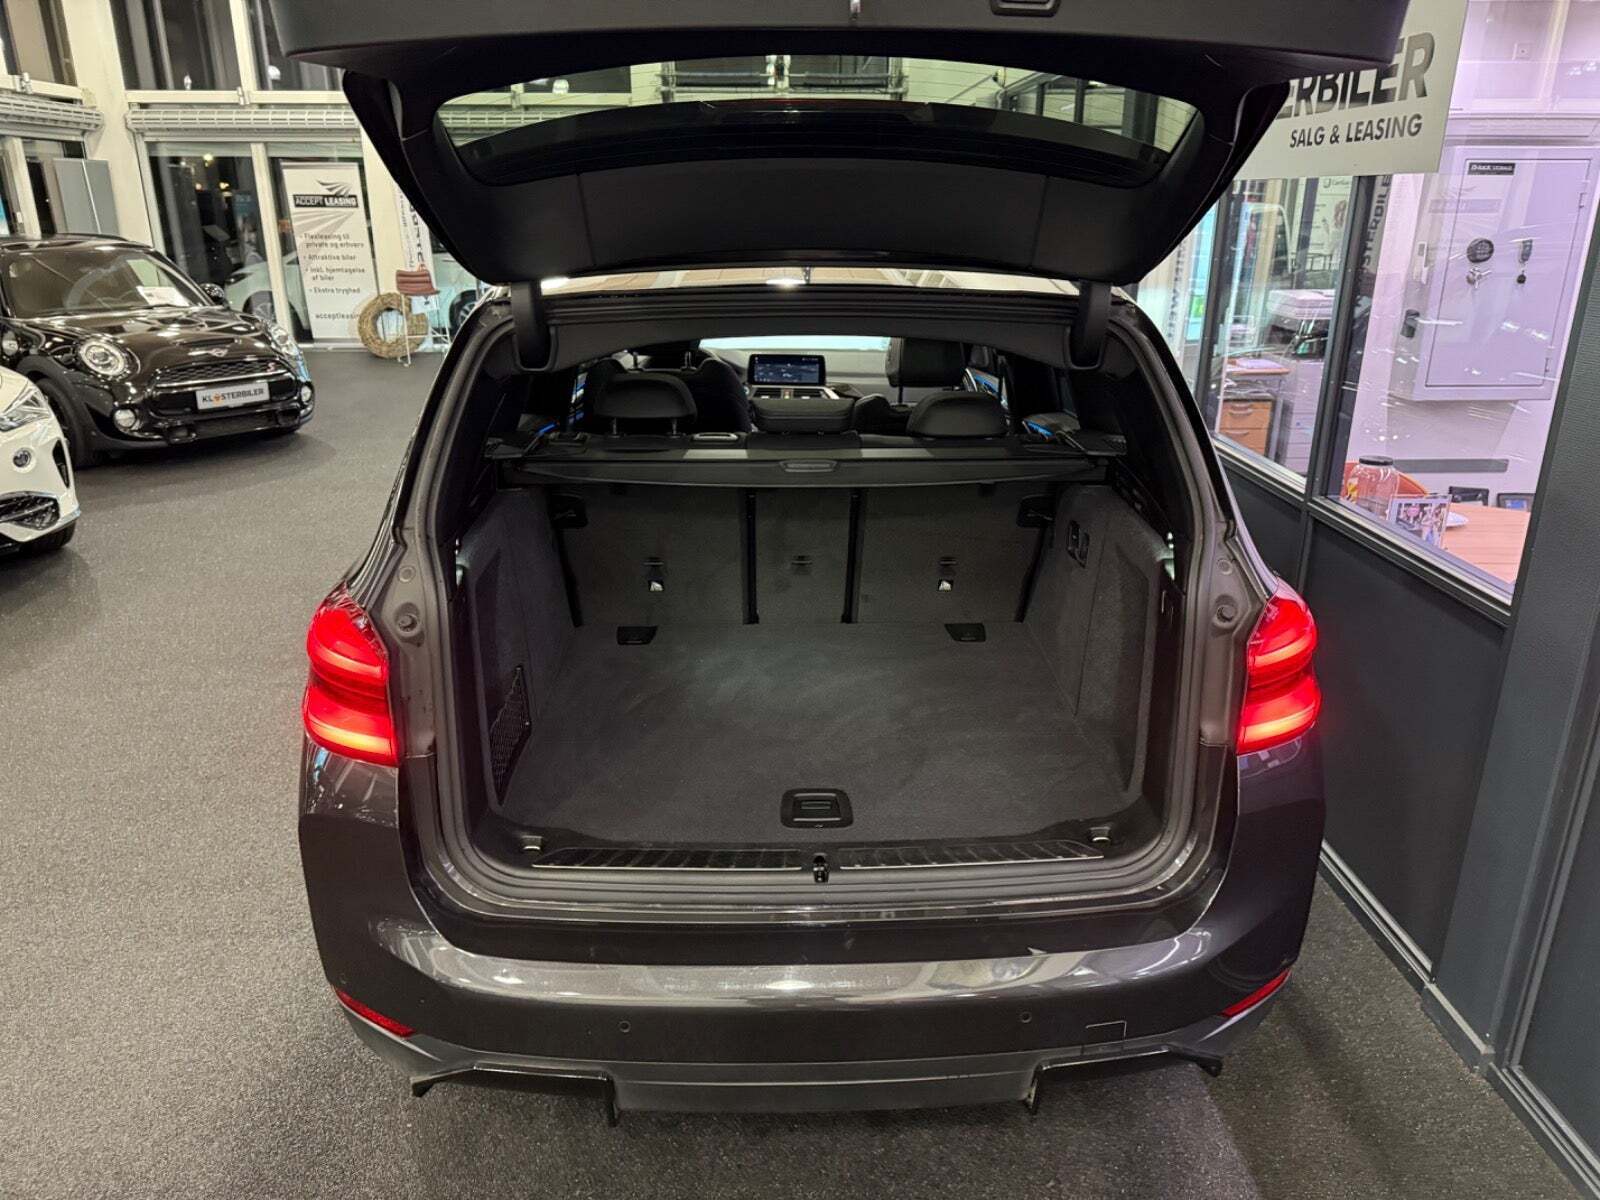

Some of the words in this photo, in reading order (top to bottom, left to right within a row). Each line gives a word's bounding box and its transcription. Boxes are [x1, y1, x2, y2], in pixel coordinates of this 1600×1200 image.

[1290, 126, 1325, 148] SALG
[1329, 124, 1340, 145] &
[1346, 113, 1423, 143] LEASING
[295, 196, 323, 206] ACCEPT
[324, 196, 357, 207] LEASING
[305, 241, 328, 249] private
[308, 253, 340, 261] Attraktive
[312, 273, 319, 281] af
[319, 273, 334, 281] biler
[313, 286, 335, 294] Ekstra
[335, 286, 361, 295] tryghed
